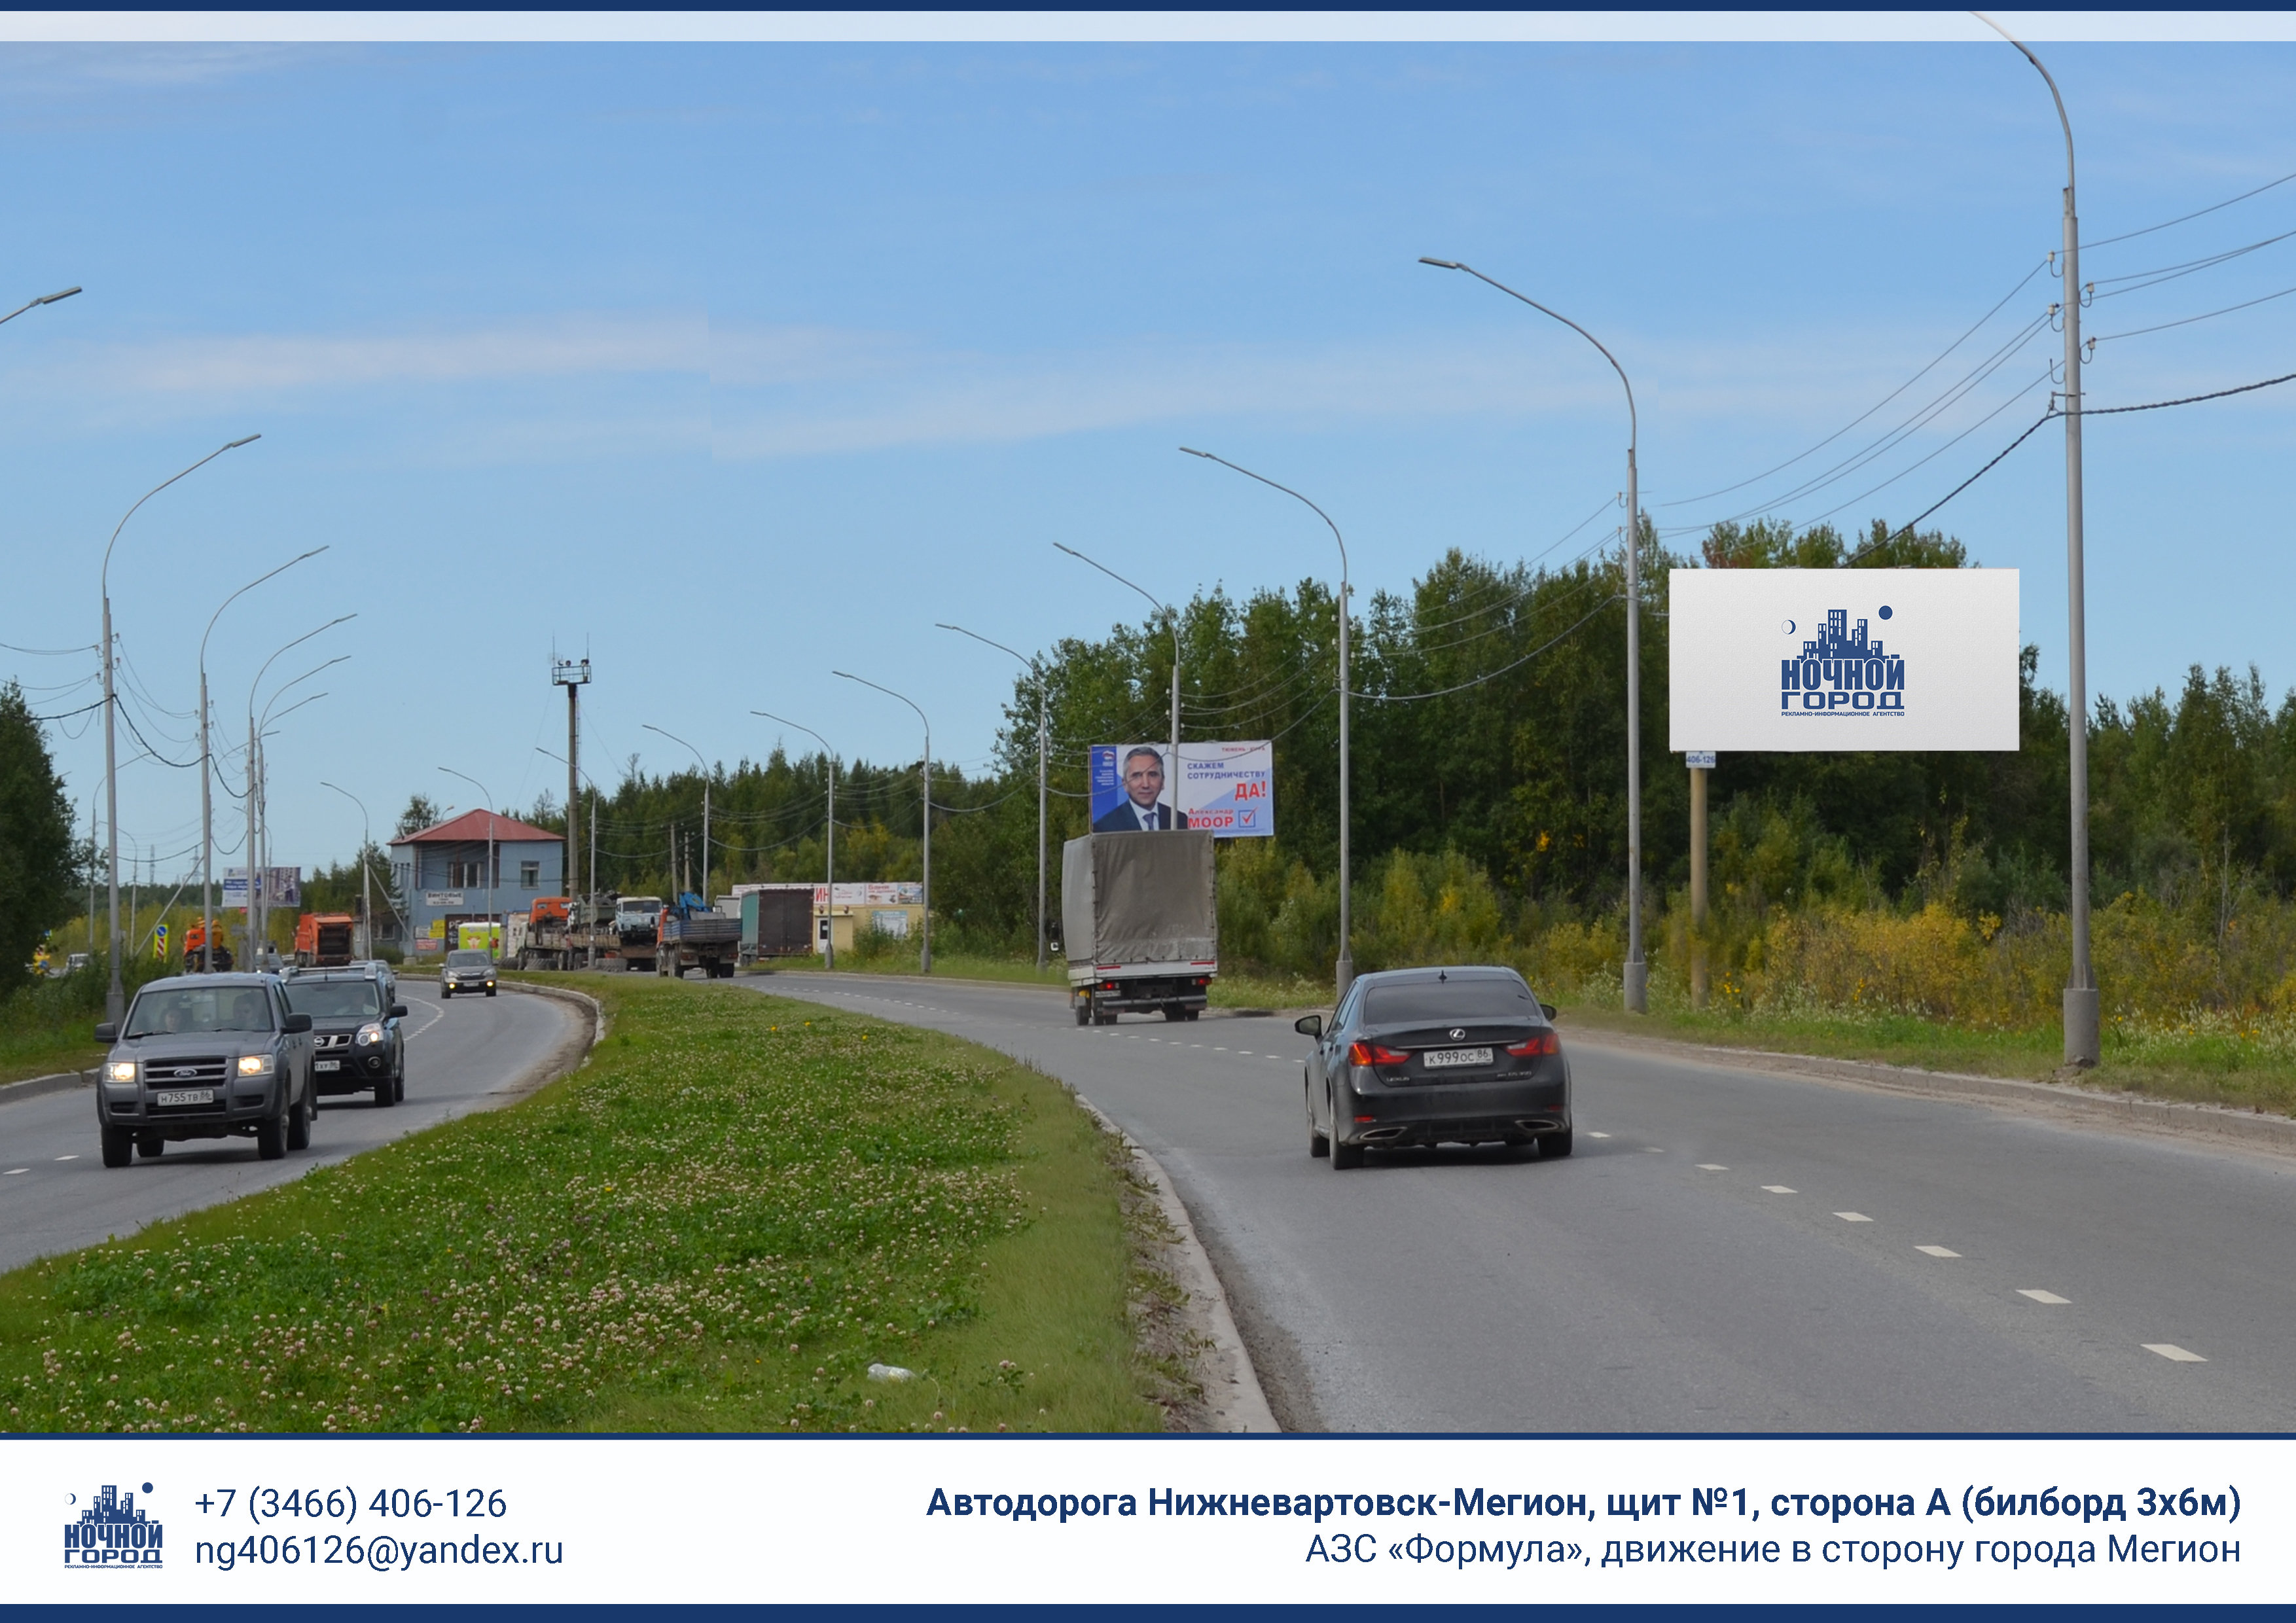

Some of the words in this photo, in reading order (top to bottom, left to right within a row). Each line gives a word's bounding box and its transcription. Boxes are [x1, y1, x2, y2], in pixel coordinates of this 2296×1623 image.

[1782, 654, 1905, 690] НОЧНОЙ
[1782, 692, 1905, 709] ГОРОД
[1187, 771, 1265, 779] СОТРУДНИЧЕСТВУ
[1234, 781, 1266, 802] ДА!
[1188, 816, 1234, 828] МООР
